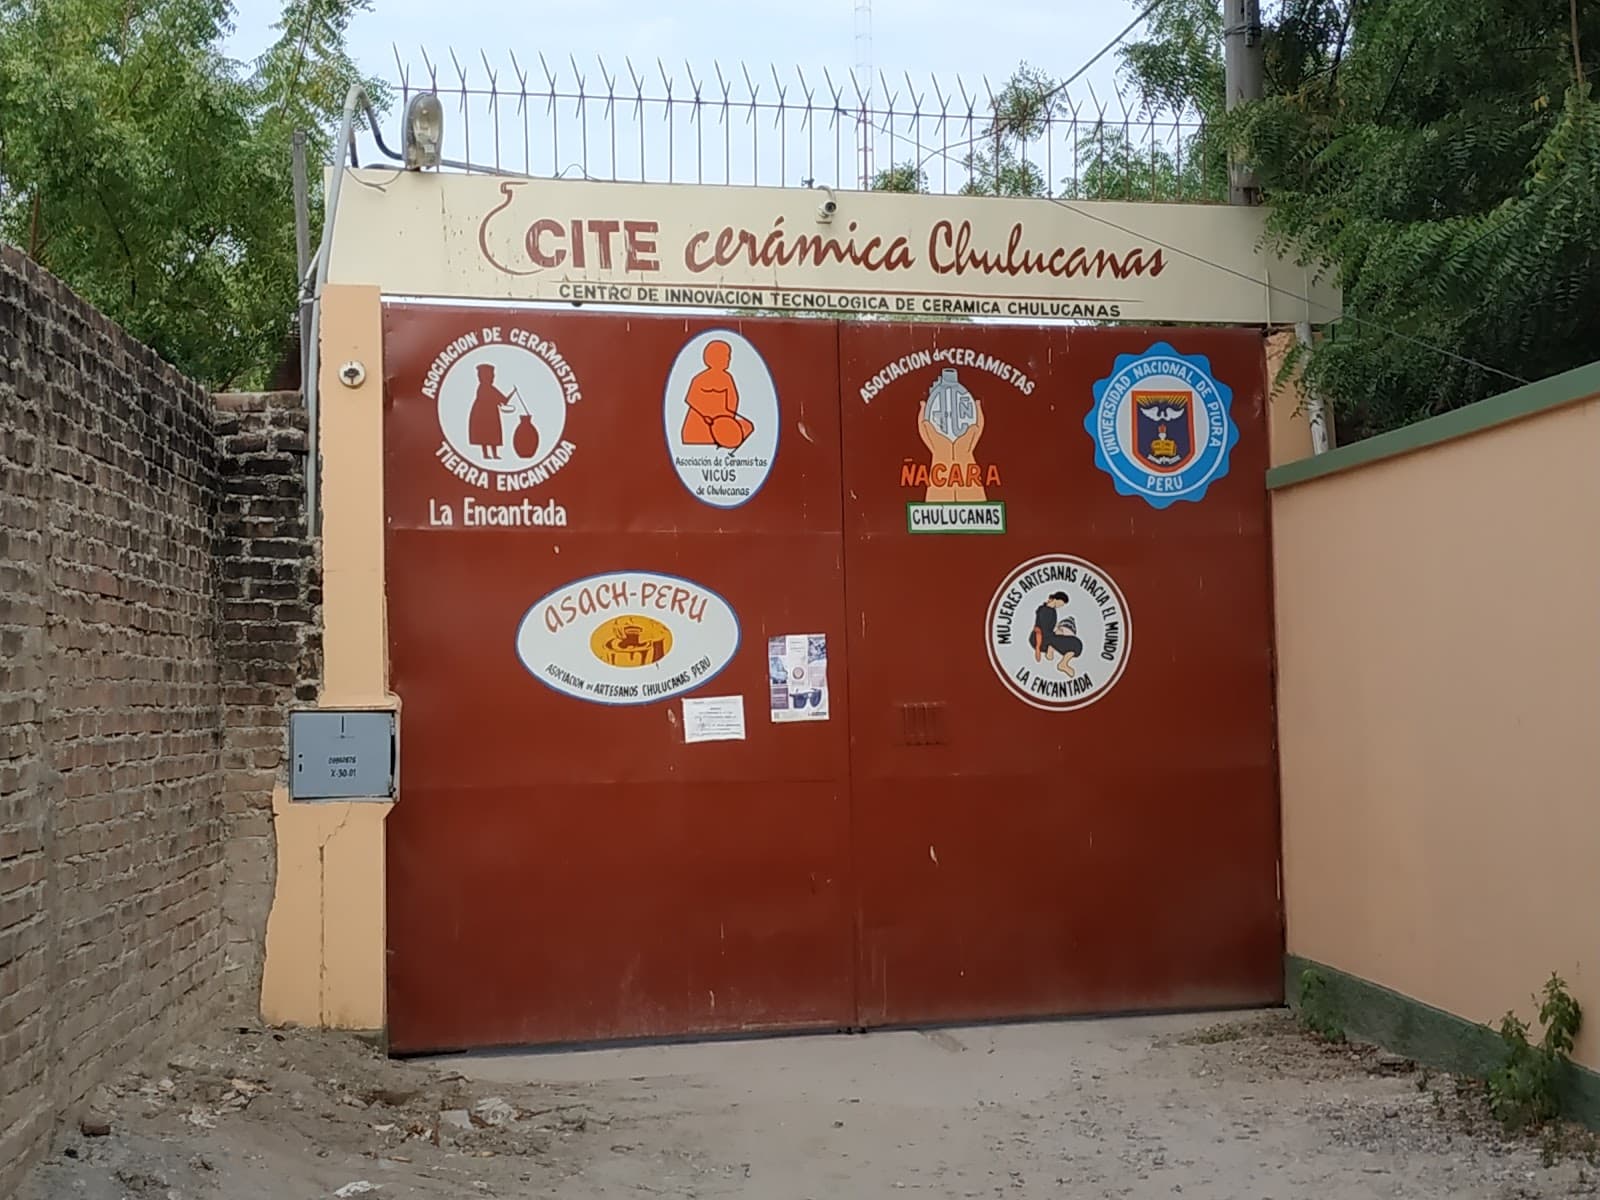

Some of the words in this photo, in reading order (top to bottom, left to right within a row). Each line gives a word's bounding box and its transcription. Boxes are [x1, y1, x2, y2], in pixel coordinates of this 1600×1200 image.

[525, 218, 660, 272] CITE
[685, 215, 916, 274] cerámica
[928, 219, 1169, 280] Chulucanas
[559, 284, 632, 300] CENTRO
[637, 287, 659, 302] DE
[664, 287, 763, 306] INNOVACION
[770, 291, 889, 310] TECNOLOGICA
[895, 297, 915, 311] DE
[922, 298, 1001, 314] CERAMICA
[1007, 302, 1121, 318] CHULUCANAS
[421, 331, 479, 399] ASOCIACION
[482, 326, 502, 343] DE
[510, 328, 582, 404] CERAMISTAS
[859, 350, 932, 404] ASOCIACION
[948, 347, 1036, 396] CERAMISTAS
[1101, 375, 1131, 455] UNIVERSIDAD
[1133, 361, 1194, 384] NACIONAL
[1196, 379, 1212, 399] DE
[1207, 400, 1224, 448] PIURA
[434, 441, 489, 490] TIERRA
[496, 440, 577, 492] ENCANTADA
[713, 456, 723, 467] de
[724, 456, 768, 467] Ceramistas
[901, 457, 1001, 488] ÑACARA
[696, 485, 705, 496] de
[707, 484, 750, 496] Chulucanas
[1146, 475, 1184, 492] PERU
[429, 498, 453, 527] La
[464, 496, 567, 527] Encantada
[912, 506, 1000, 527] CHULUCANAS
[1018, 565, 1080, 593] ARTESANAS
[1080, 573, 1110, 608] HACIA
[997, 588, 1024, 645] MUJERES
[1101, 606, 1117, 621] EL
[1101, 621, 1120, 662] MUNDO
[593, 683, 639, 697] ARTESANOS
[642, 671, 691, 697] CHULUCANAS
[1016, 666, 1030, 687] LA
[1030, 672, 1094, 698] ENCANTADA
